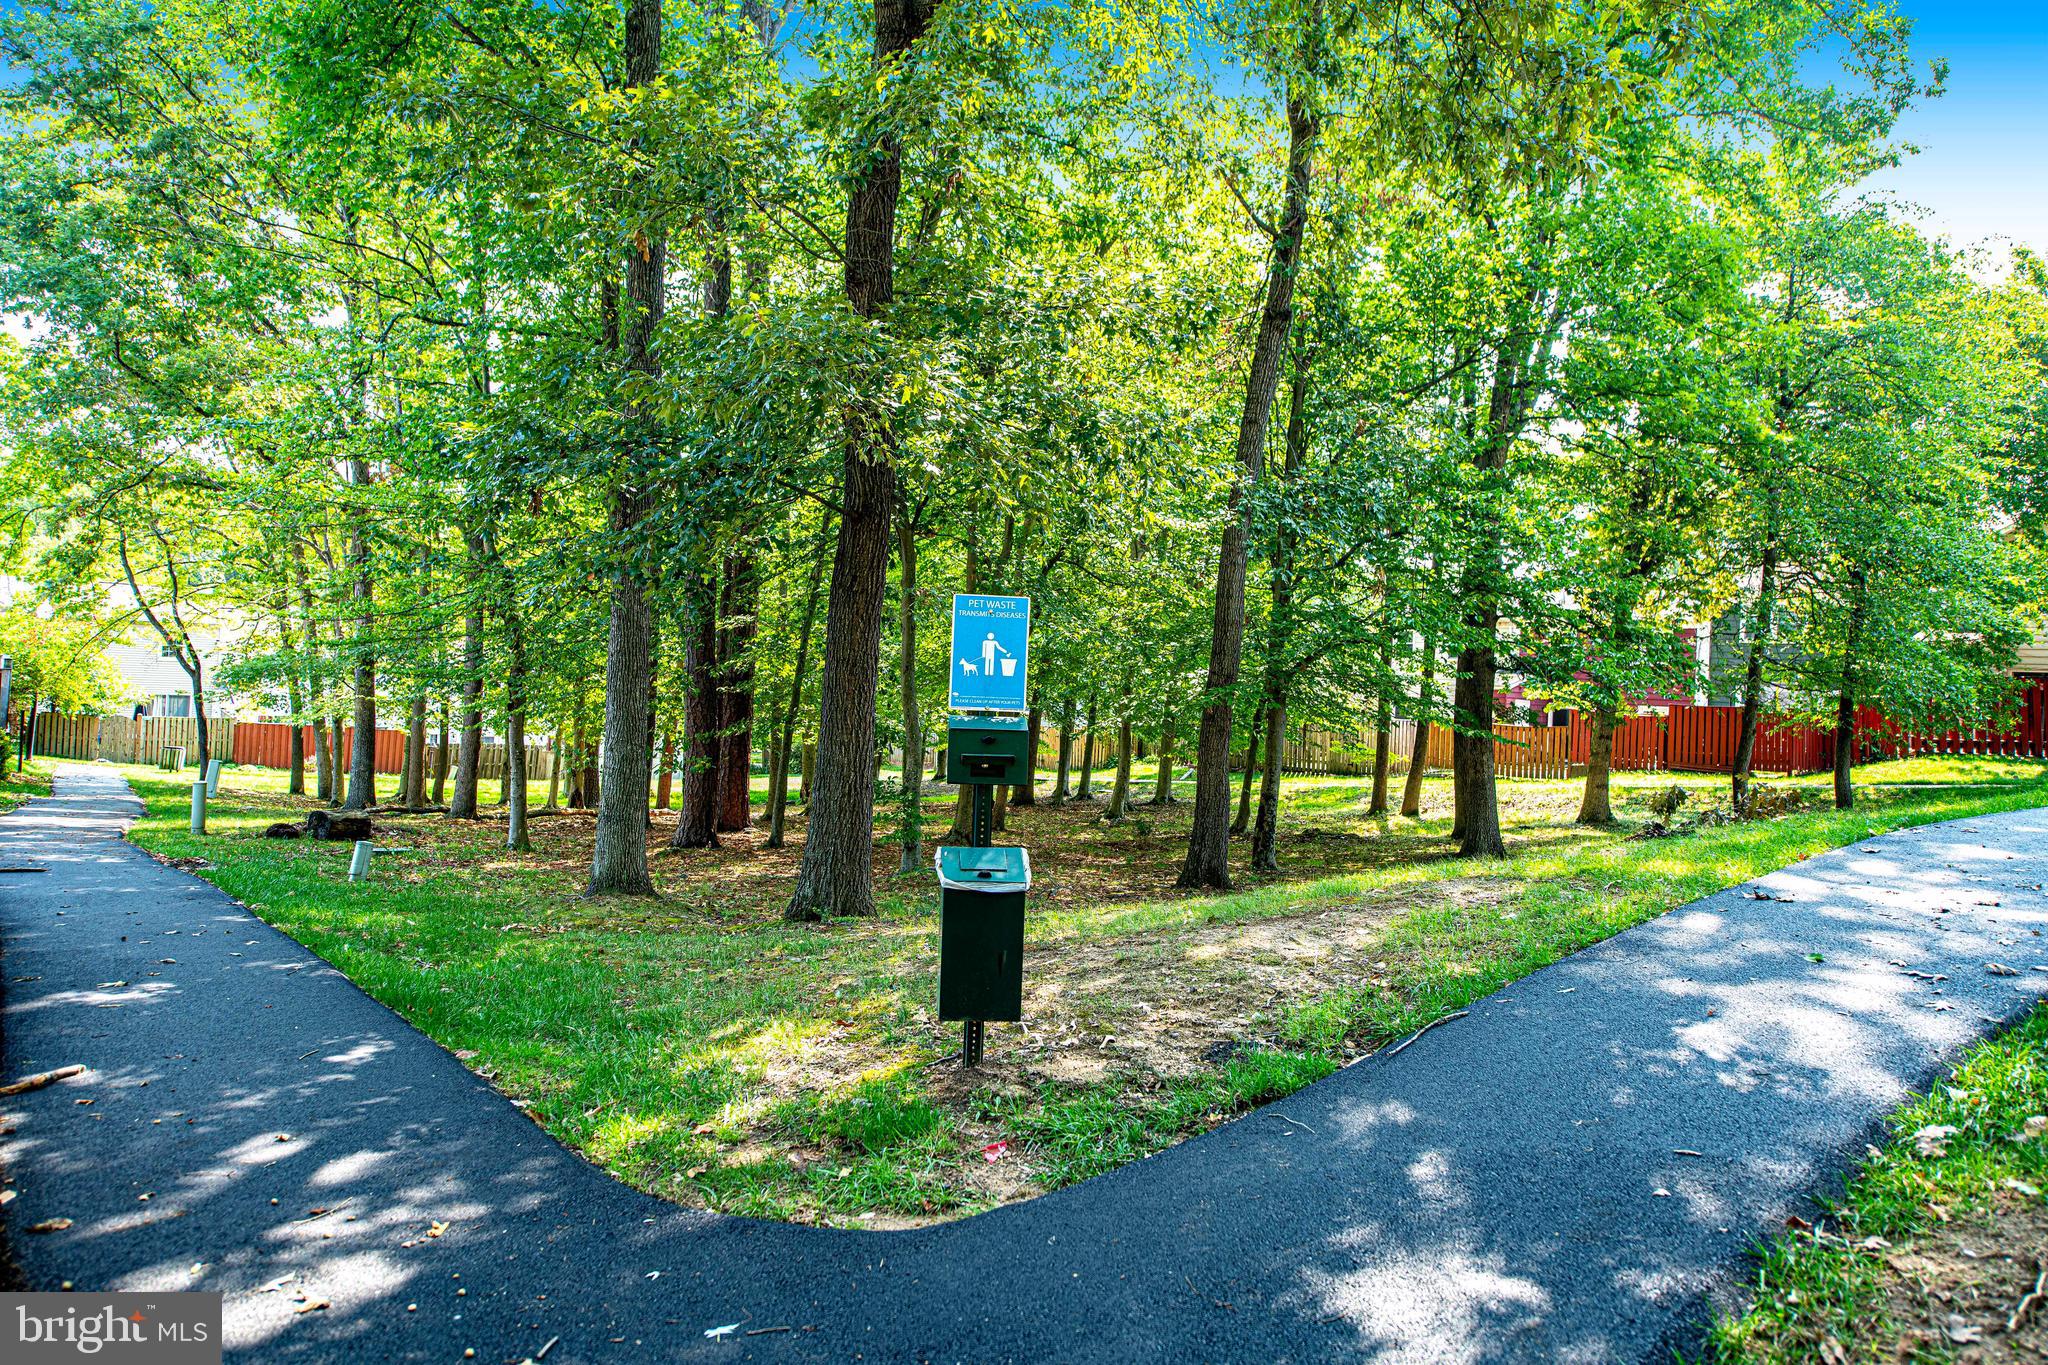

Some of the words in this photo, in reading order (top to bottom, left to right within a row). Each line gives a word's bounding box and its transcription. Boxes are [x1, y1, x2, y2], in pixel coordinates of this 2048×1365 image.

[968, 599, 984, 608] PET
[986, 600, 1016, 610] WASTE
[996, 611, 1026, 619] DISEASES
